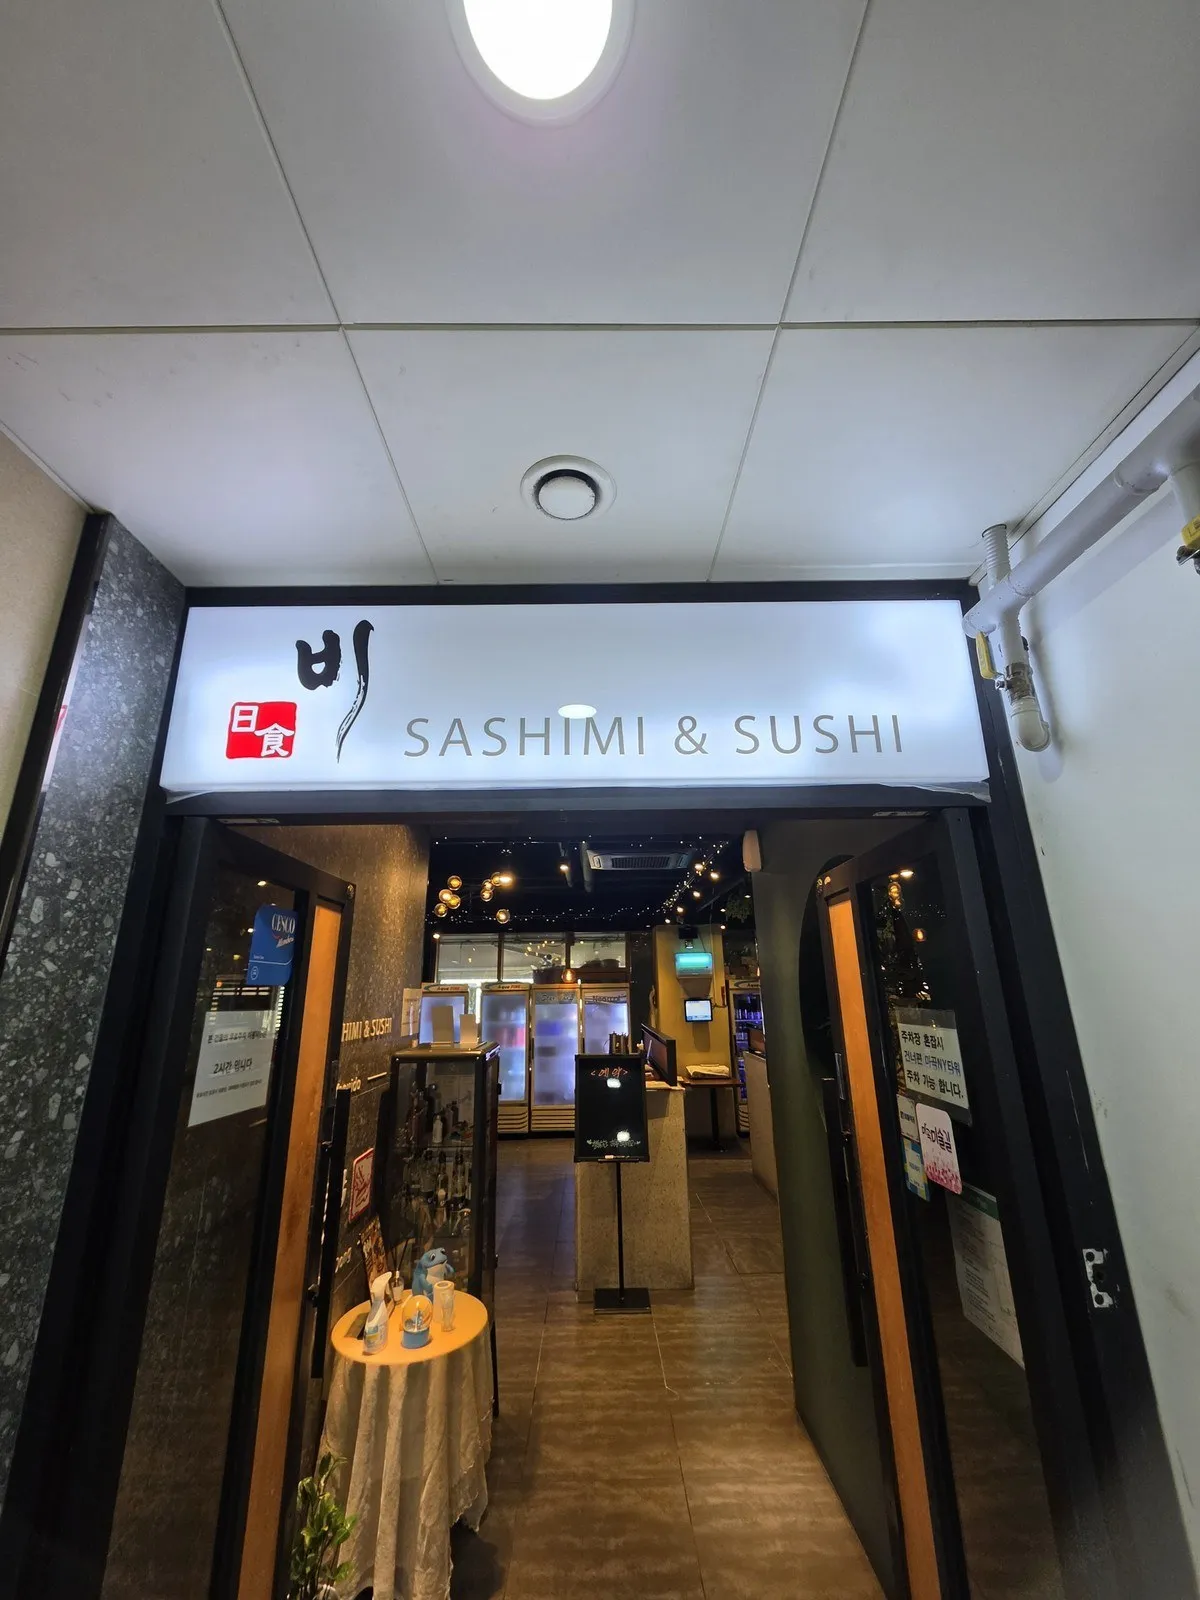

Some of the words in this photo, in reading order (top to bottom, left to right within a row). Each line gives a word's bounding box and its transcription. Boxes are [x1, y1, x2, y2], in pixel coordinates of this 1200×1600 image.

[295, 619, 375, 764] 비
[404, 715, 646, 757] SASHIMI
[674, 715, 709, 755] &
[735, 714, 904, 756] SUSHI
[272, 913, 295, 933] CESCO
[363, 1020, 370, 1038] &
[370, 1017, 393, 1037] SUSHI
[901, 1030, 921, 1046] 주차장
[923, 1033, 945, 1050] 혼잡시
[213, 1060, 233, 1074] 2시간
[233, 1058, 253, 1072] 입니다
[904, 1050, 923, 1065] 건너편
[906, 1069, 920, 1085] 주차
[922, 1074, 936, 1091] 가능
[938, 1077, 964, 1099] 합니다.
